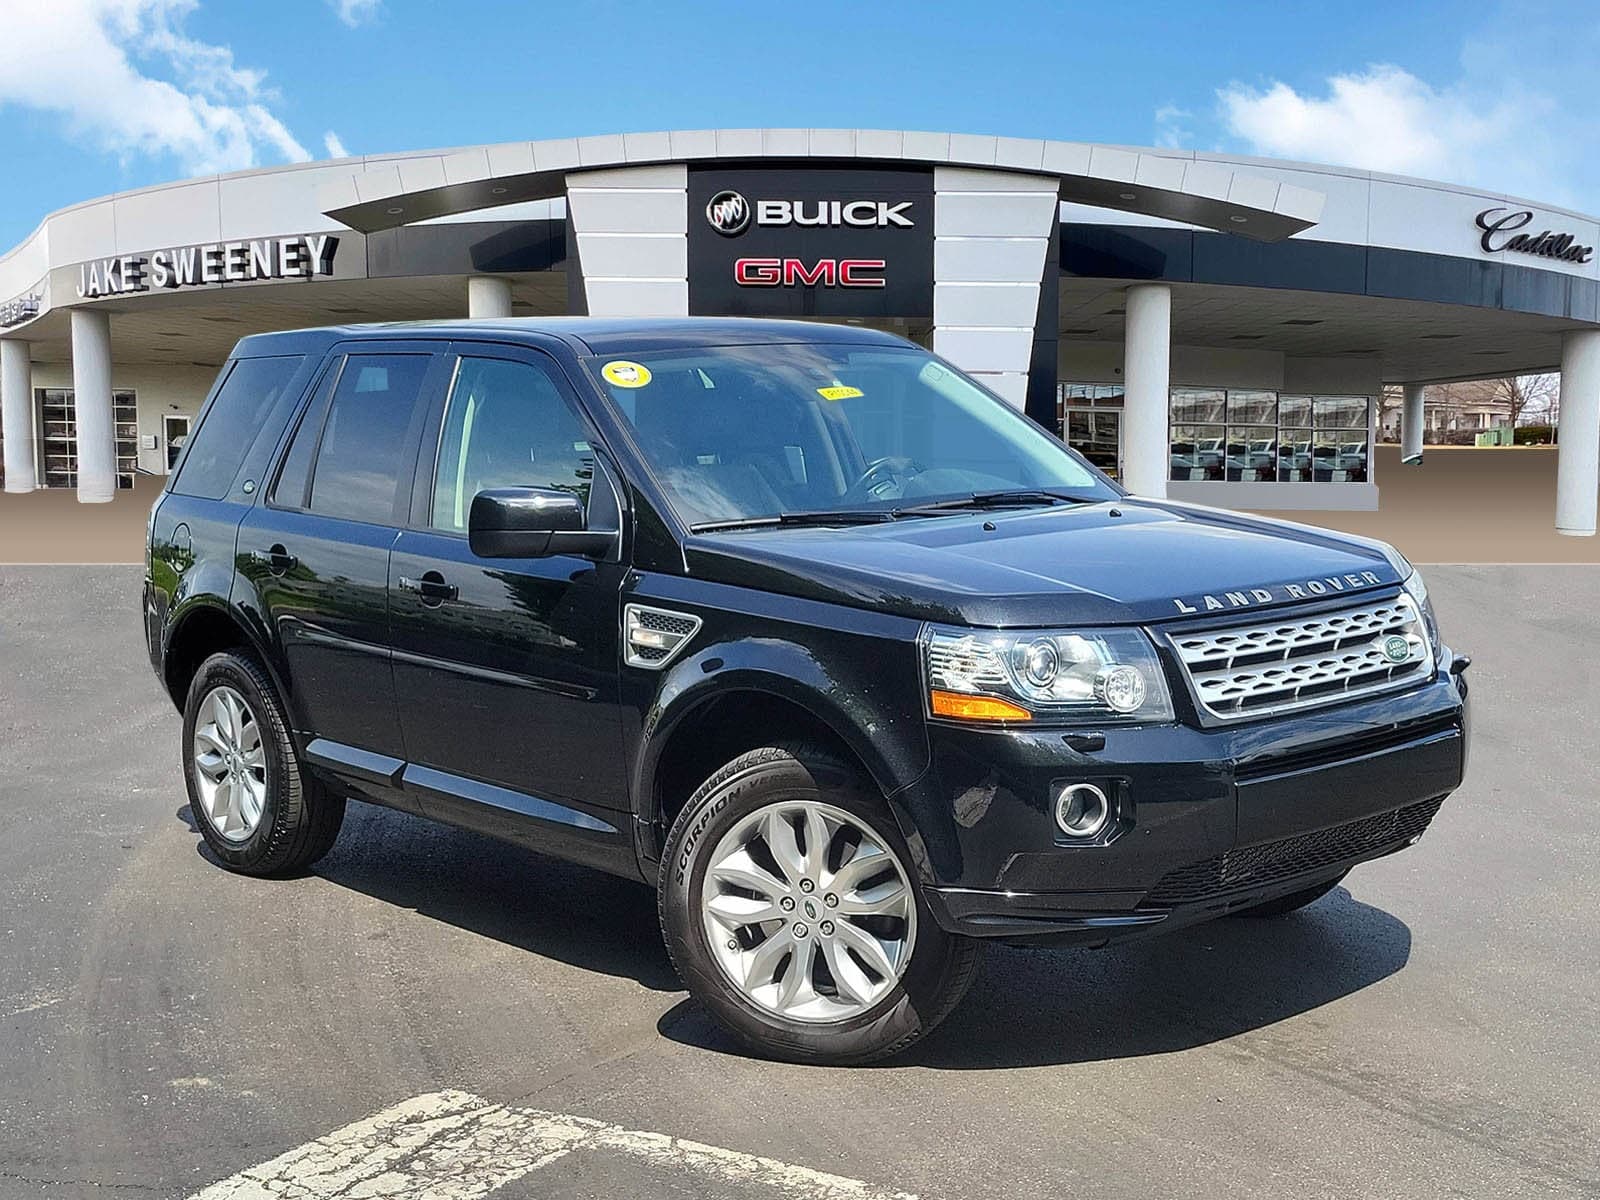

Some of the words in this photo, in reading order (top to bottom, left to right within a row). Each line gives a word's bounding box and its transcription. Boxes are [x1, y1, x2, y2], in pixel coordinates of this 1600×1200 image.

[757, 200, 915, 226] BUICK
[1475, 207, 1593, 264] Cadillac
[77, 256, 143, 298] JAKE
[151, 235, 333, 288] SWEENEY
[734, 258, 886, 287] GMC
[1173, 588, 1274, 614] LAND
[1284, 570, 1381, 600] ROVER
[675, 788, 742, 887] SCORPION
